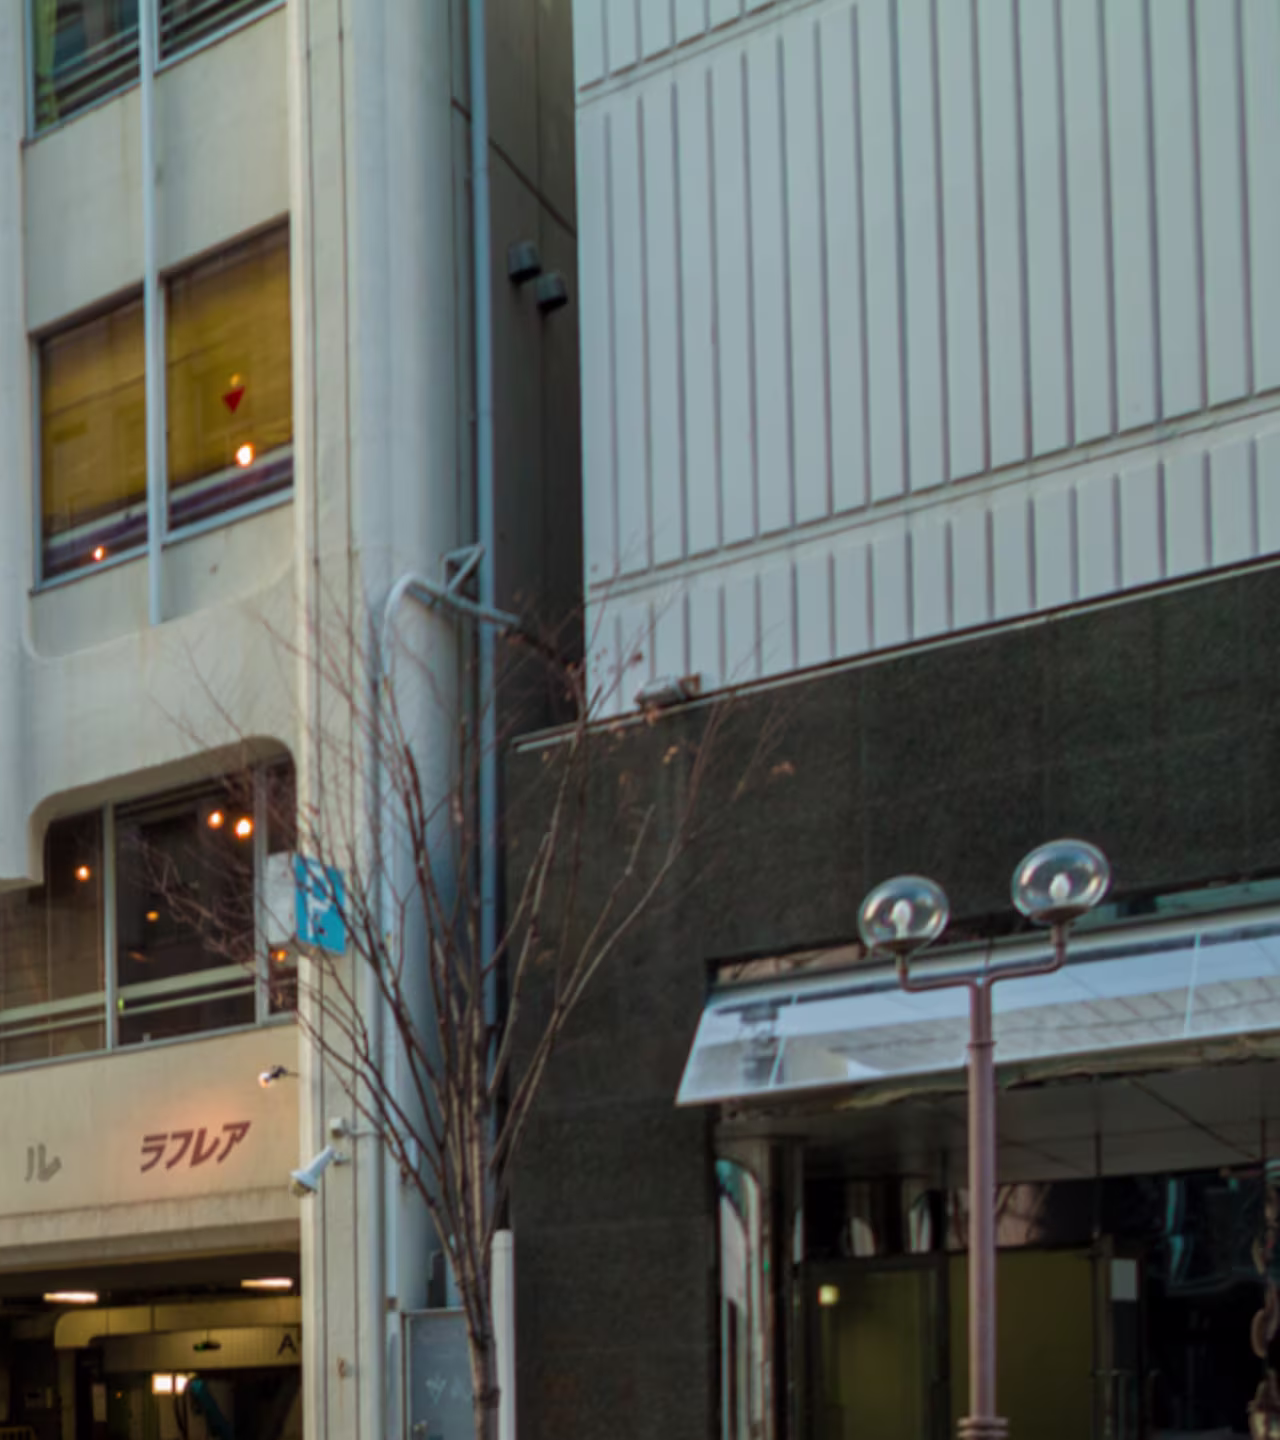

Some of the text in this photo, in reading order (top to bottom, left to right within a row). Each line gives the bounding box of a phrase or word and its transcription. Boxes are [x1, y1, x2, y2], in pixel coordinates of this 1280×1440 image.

[306, 864, 334, 938] P
[141, 1121, 251, 1173] ラフレア
